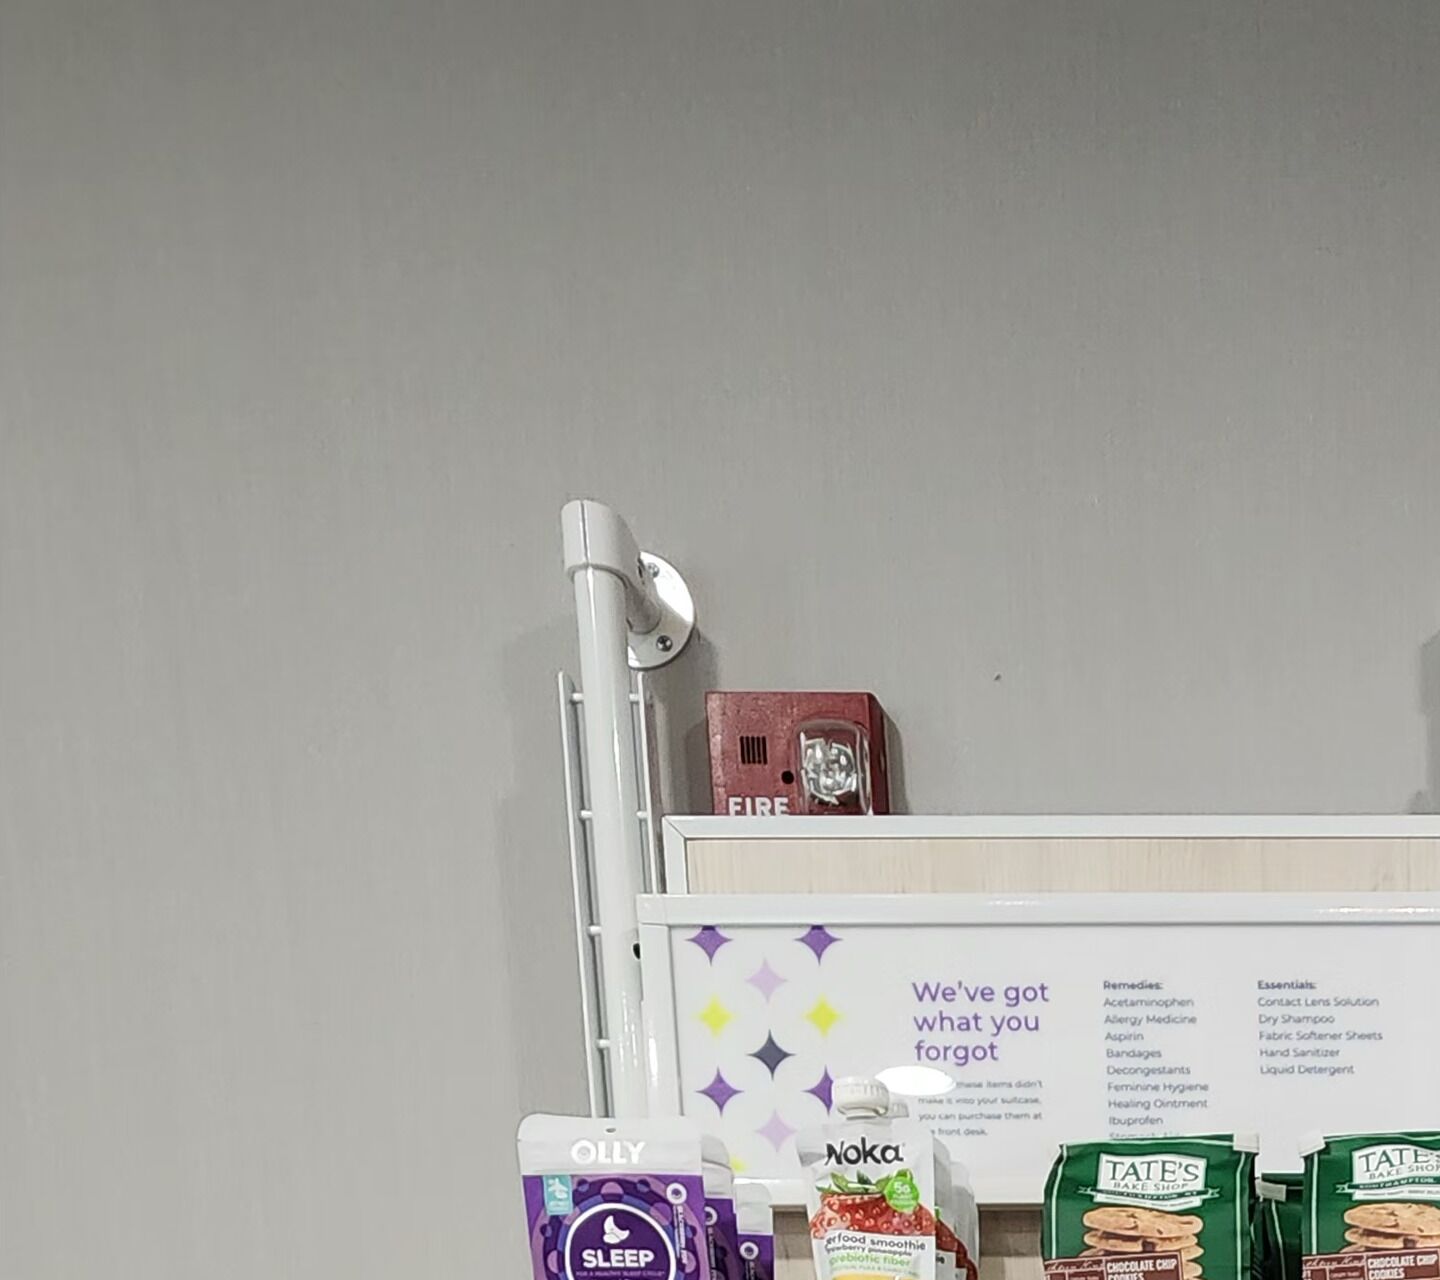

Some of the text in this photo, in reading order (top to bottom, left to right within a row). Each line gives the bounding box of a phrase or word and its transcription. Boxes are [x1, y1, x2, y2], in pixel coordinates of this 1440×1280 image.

[729, 797, 788, 815] FIRE
[1103, 980, 1163, 990] Remedies:
[1257, 980, 1317, 990] Essentials:
[912, 980, 1049, 1008] We've got
[1103, 997, 1194, 1009] Acetaminophen
[1258, 996, 1379, 1007] Contact Lens Solution
[913, 1011, 1040, 1036] what you
[1104, 1014, 1197, 1026] Allergy Medicine
[1258, 1014, 1335, 1026] Dry Shampoo
[1105, 1031, 1144, 1043] Aspirin
[1259, 1031, 1383, 1041] Fabric Softener Sheets
[915, 1040, 999, 1066] forgot
[1106, 1048, 1162, 1060] Bandages
[1260, 1047, 1340, 1058] Hand Sanitizer
[1106, 1065, 1191, 1076] Decongestants
[1260, 1065, 1354, 1076] Liquid Detergent
[1107, 1082, 1209, 1094] Feminine Hygiene
[1108, 1098, 1208, 1110] Healing Ointment
[1109, 1115, 1163, 1127] Ibuprofen
[571, 1139, 646, 1165] OLLY
[1105, 1159, 1200, 1183] TATE'S
[1113, 1182, 1189, 1191] BAKE SHOP
[870, 1238, 927, 1250] smoothie
[582, 1248, 655, 1268] SLEEP
[883, 1255, 911, 1266] fiber
[1107, 1258, 1178, 1273] CHOCOLATE CHIP
